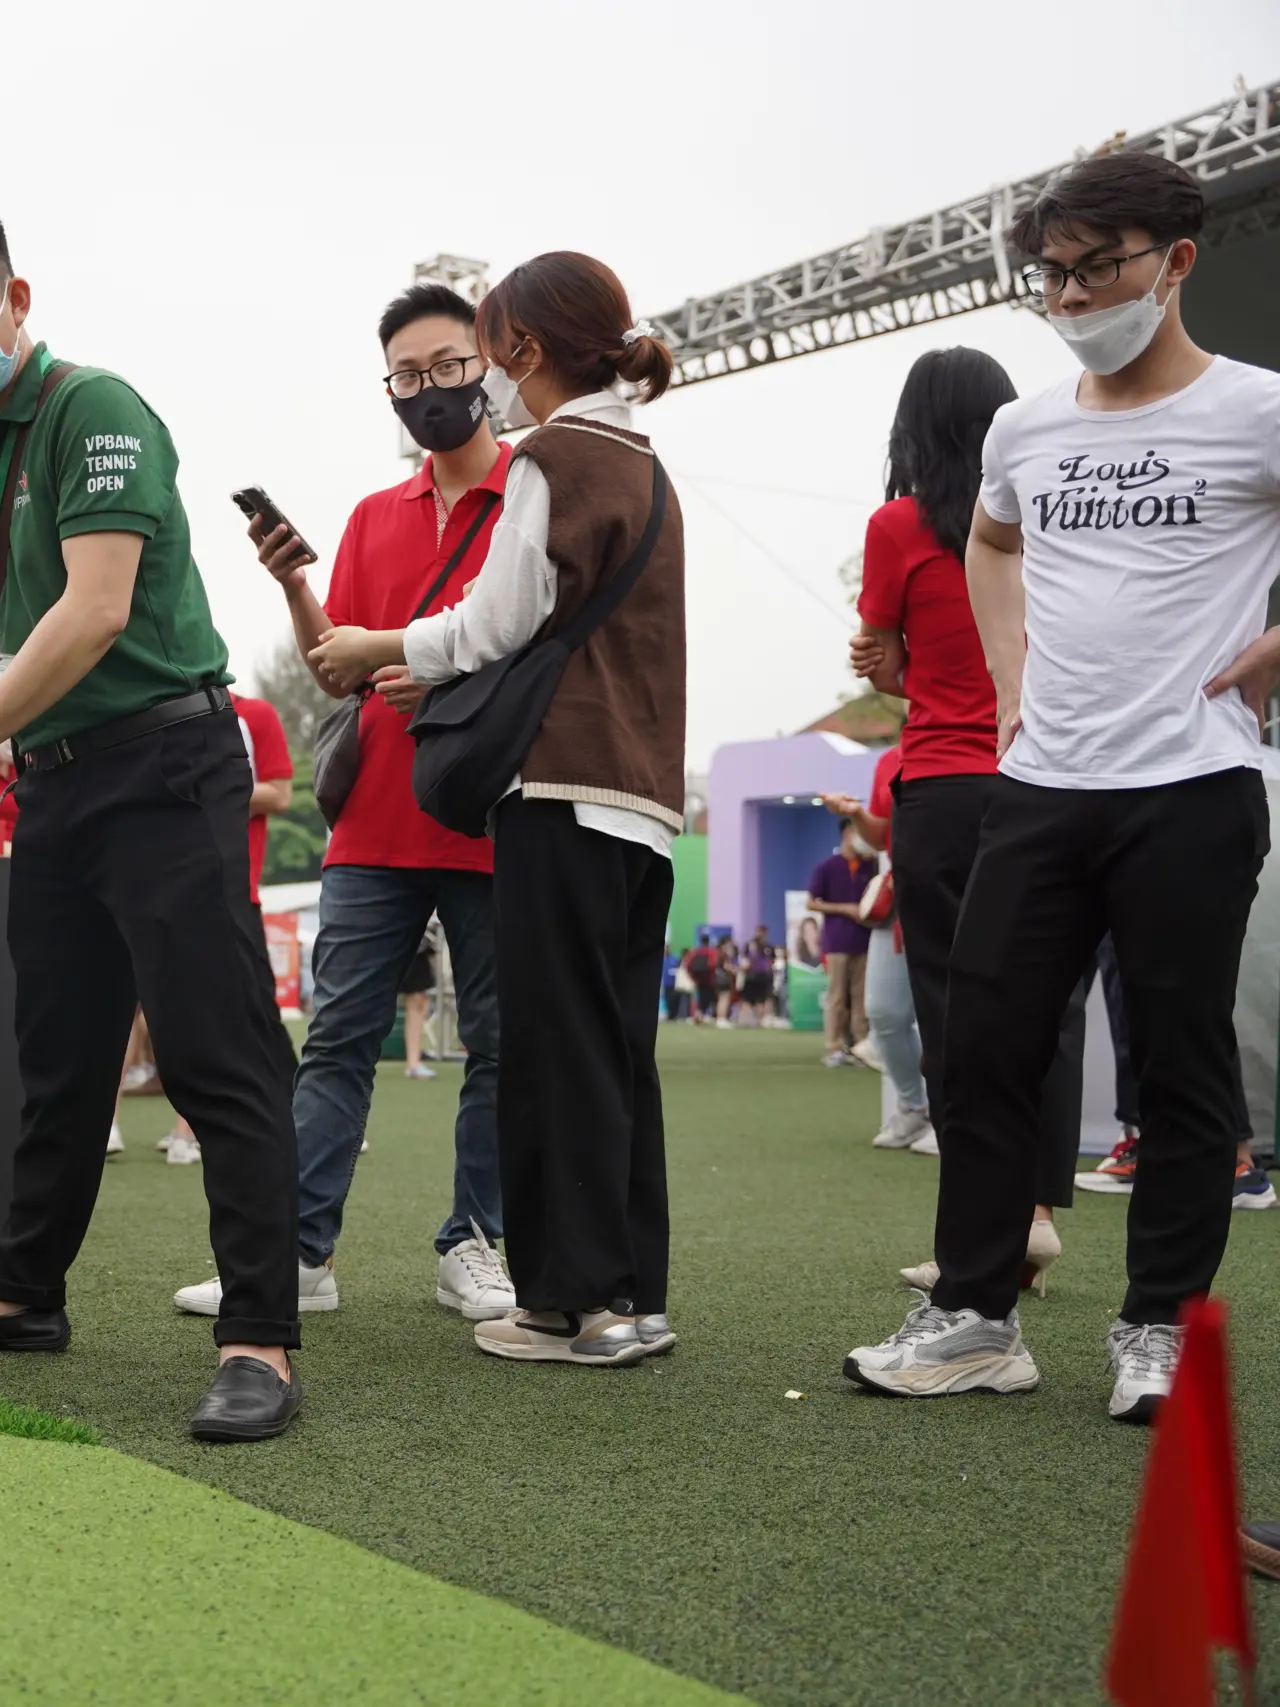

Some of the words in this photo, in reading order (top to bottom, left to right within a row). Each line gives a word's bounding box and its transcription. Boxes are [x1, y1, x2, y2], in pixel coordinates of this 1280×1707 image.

[85, 434, 142, 453] VPBANK
[85, 454, 137, 473] TENNIS
[1058, 450, 1171, 491] Louis
[87, 475, 125, 493] OPEN
